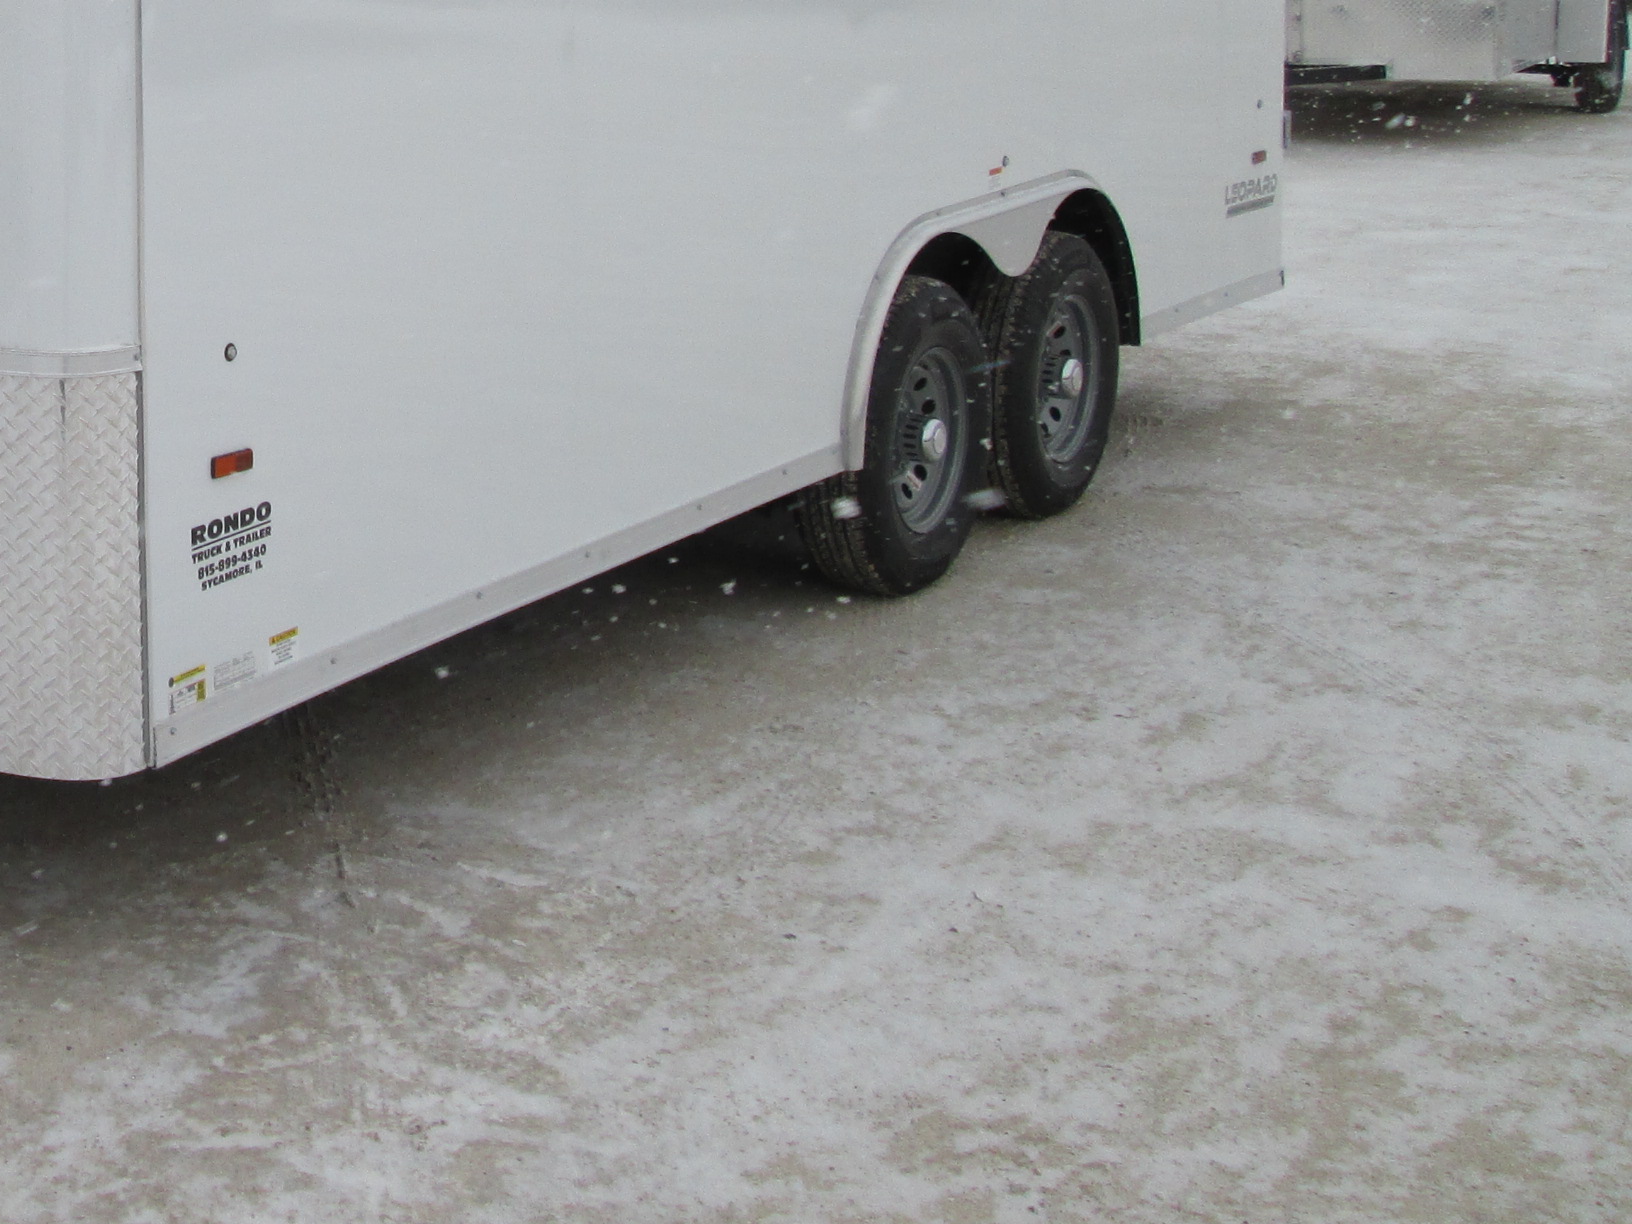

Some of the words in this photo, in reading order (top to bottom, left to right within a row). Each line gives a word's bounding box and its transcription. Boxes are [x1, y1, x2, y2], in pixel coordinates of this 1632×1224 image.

[191, 501, 272, 546] RONDO
[192, 544, 222, 564] TRUCK
[225, 541, 231, 552] &
[233, 526, 272, 549] TRAILER
[198, 544, 267, 580] 815-899-4340
[201, 564, 252, 591] SYCAMORE,
[255, 560, 263, 570] IL
